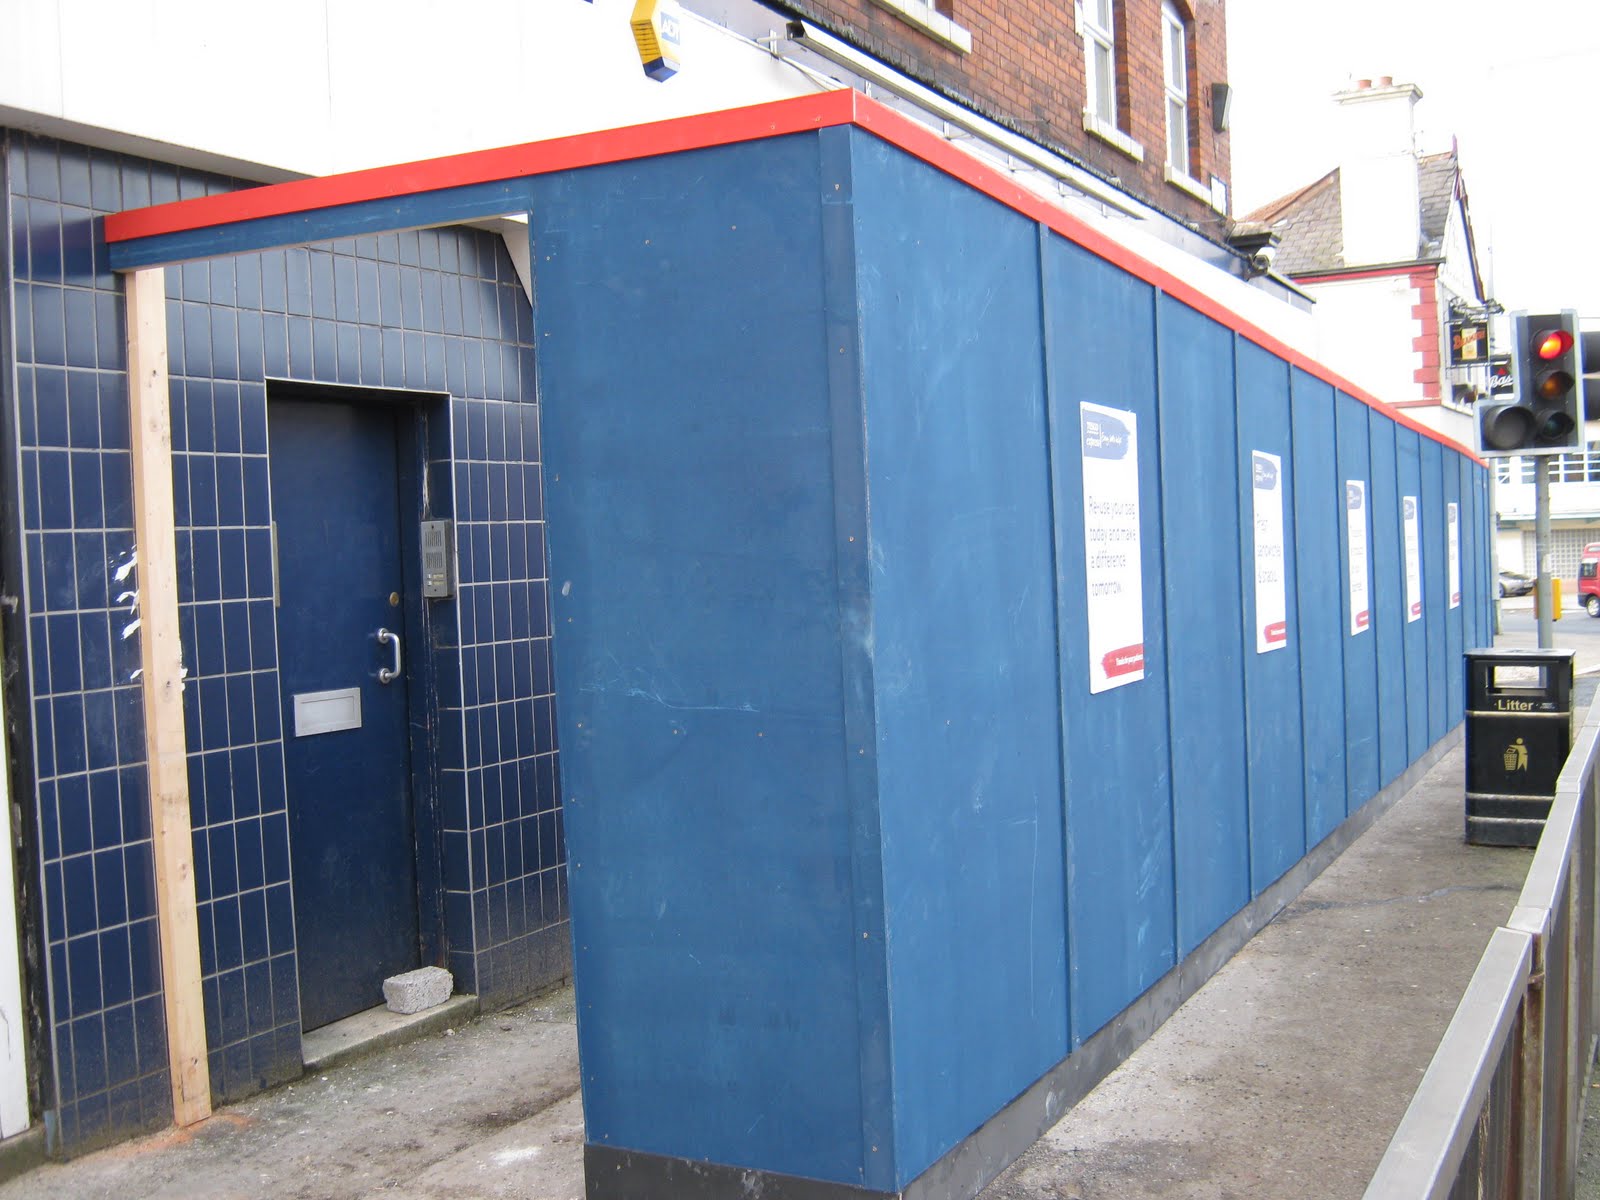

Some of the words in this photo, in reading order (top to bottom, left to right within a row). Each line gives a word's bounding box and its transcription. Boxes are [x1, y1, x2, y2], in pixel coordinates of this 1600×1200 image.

[1490, 374, 1513, 388] Bas
[1089, 495, 1110, 515] Re-use
[1111, 502, 1124, 519] your
[1089, 524, 1107, 546] today
[1108, 524, 1119, 541] and
[1120, 524, 1136, 541] make
[1091, 555, 1096, 568] a
[1096, 549, 1126, 568] difference
[1497, 699, 1534, 711] Litter
